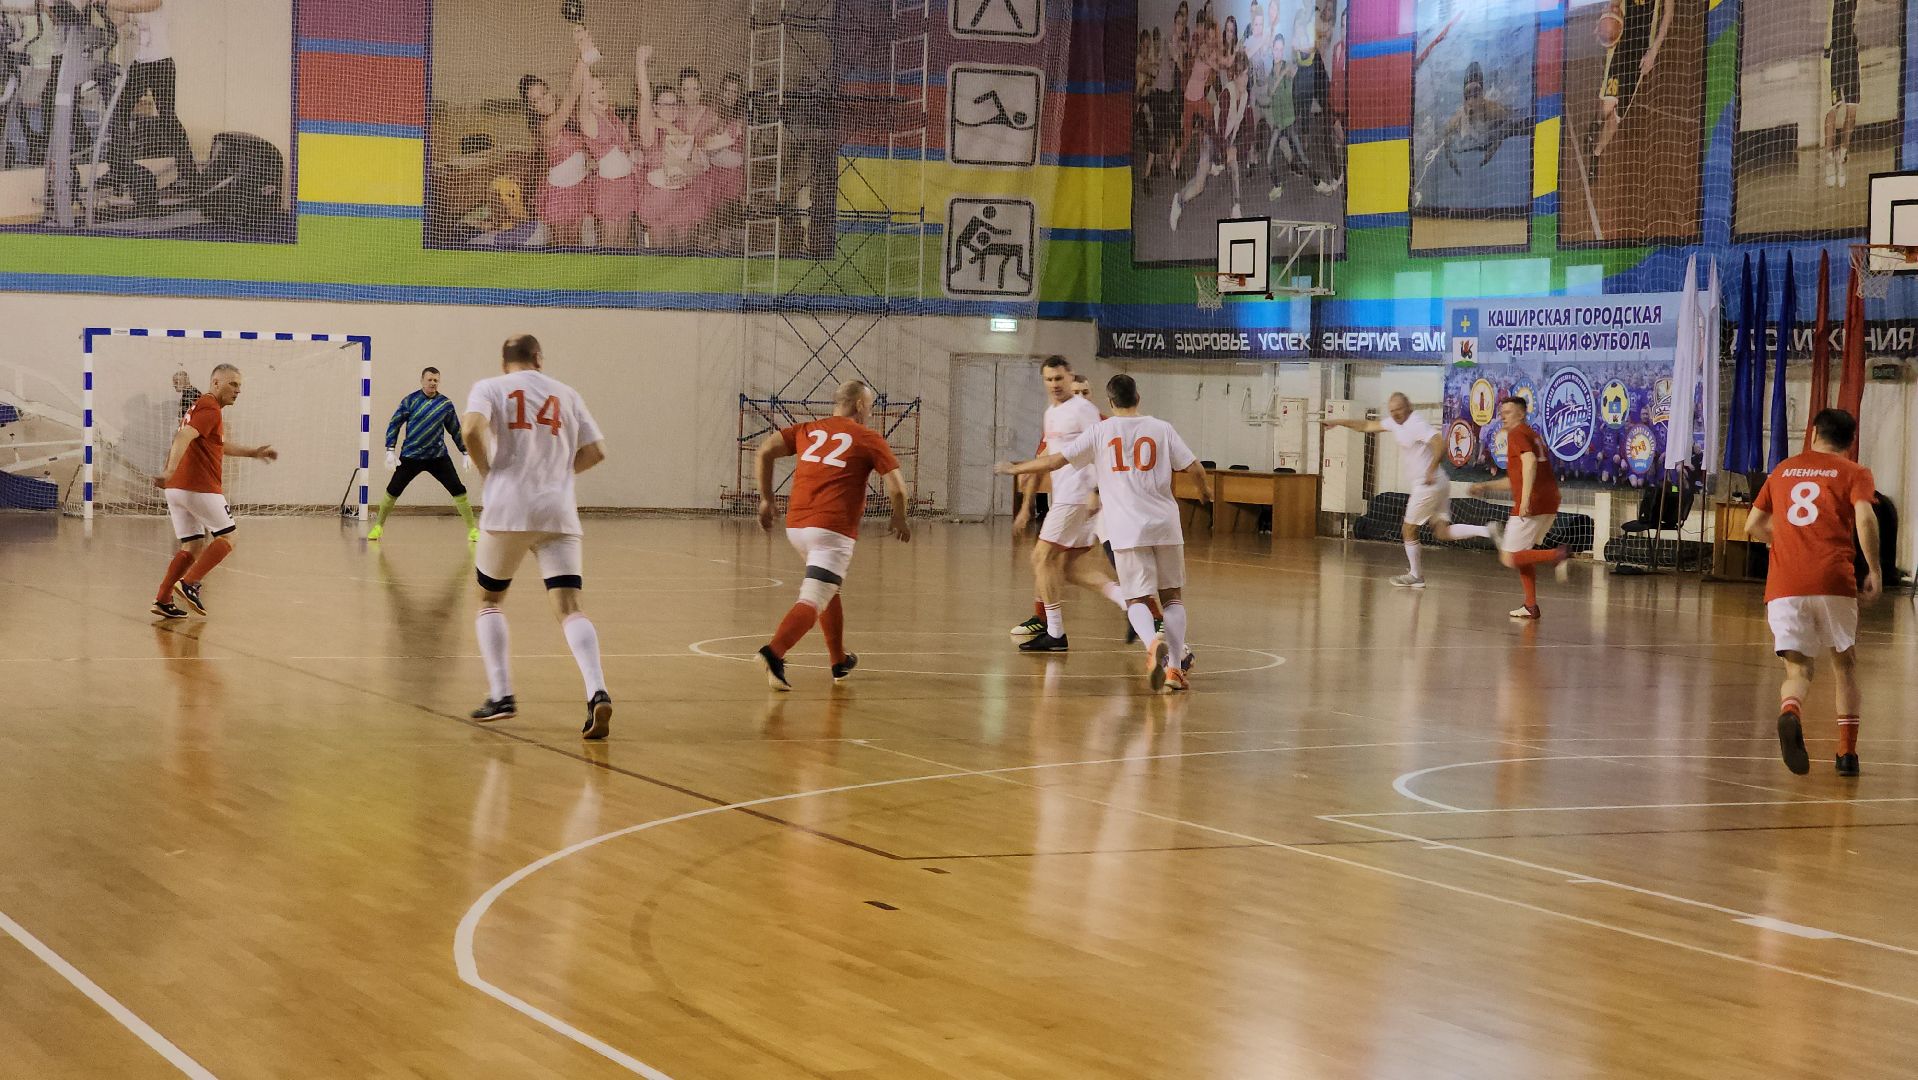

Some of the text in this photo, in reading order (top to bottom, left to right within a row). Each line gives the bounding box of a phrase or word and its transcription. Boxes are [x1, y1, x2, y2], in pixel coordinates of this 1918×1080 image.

[1488, 305, 1662, 328] КАШИРСКАЯ ГОРОДСКАЯ
[1112, 331, 1446, 353] МЕЧТА ЗДОРОВЬЕ УСПЕХ ЭНЕРГИЯ ЭМ
[1496, 331, 1650, 355] ФЕДЕРАЦИЯ ФУТБОЛА
[508, 389, 561, 436] 14
[800, 429, 853, 468] 22
[1107, 436, 1157, 472] 10
[1787, 481, 1820, 527] 8
